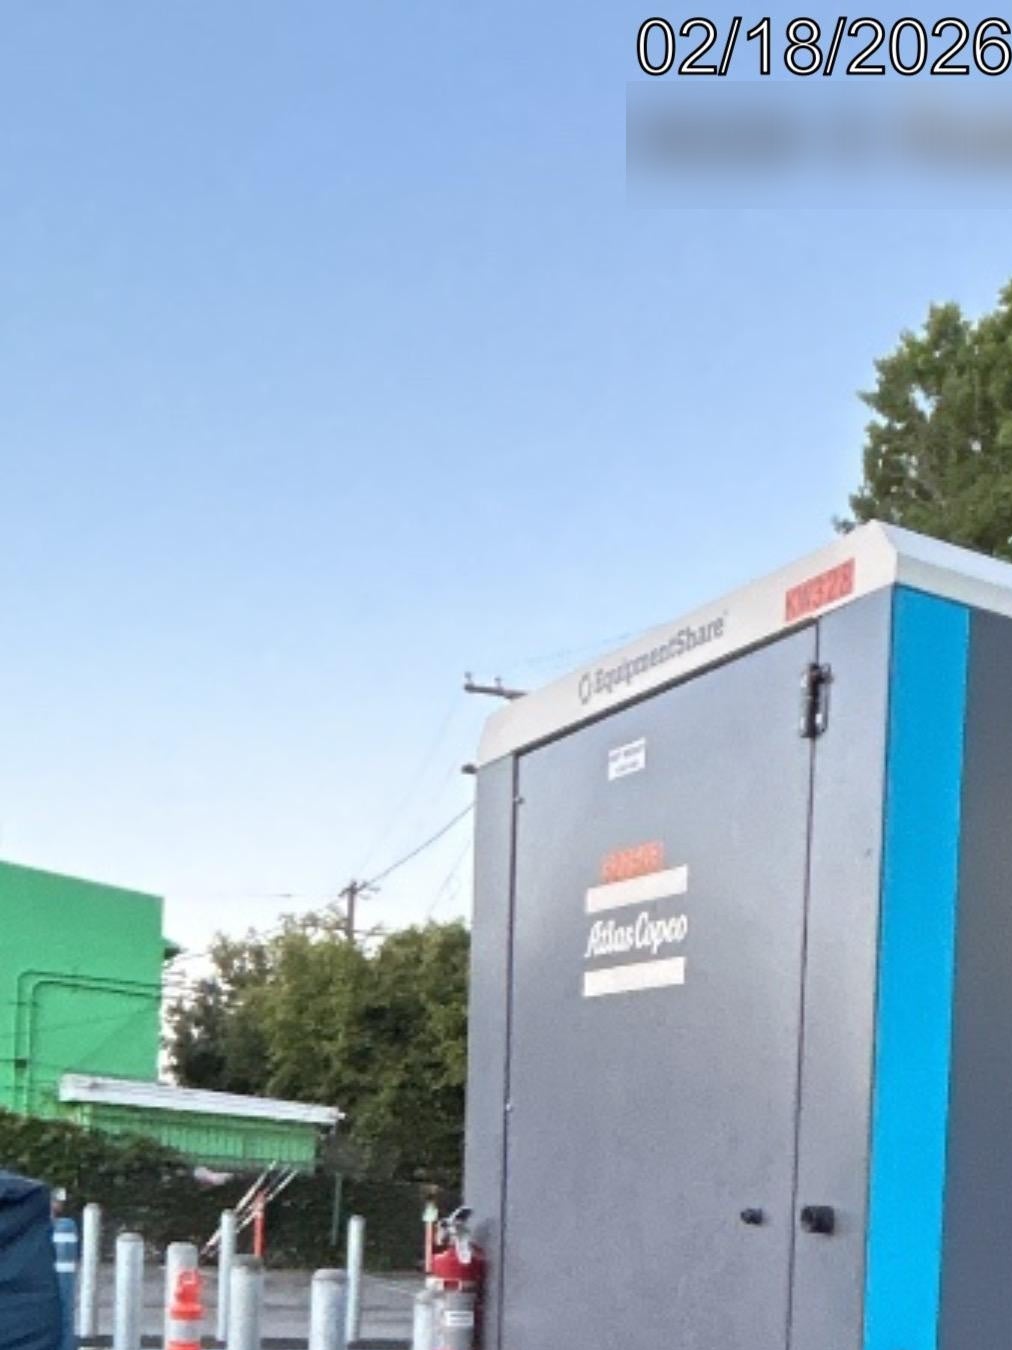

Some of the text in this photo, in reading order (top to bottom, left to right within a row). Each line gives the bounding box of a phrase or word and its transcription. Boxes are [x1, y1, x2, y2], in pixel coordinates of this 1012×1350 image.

[593, 616, 725, 695] EquipmentShare
[583, 910, 689, 958] Atlas Copco
